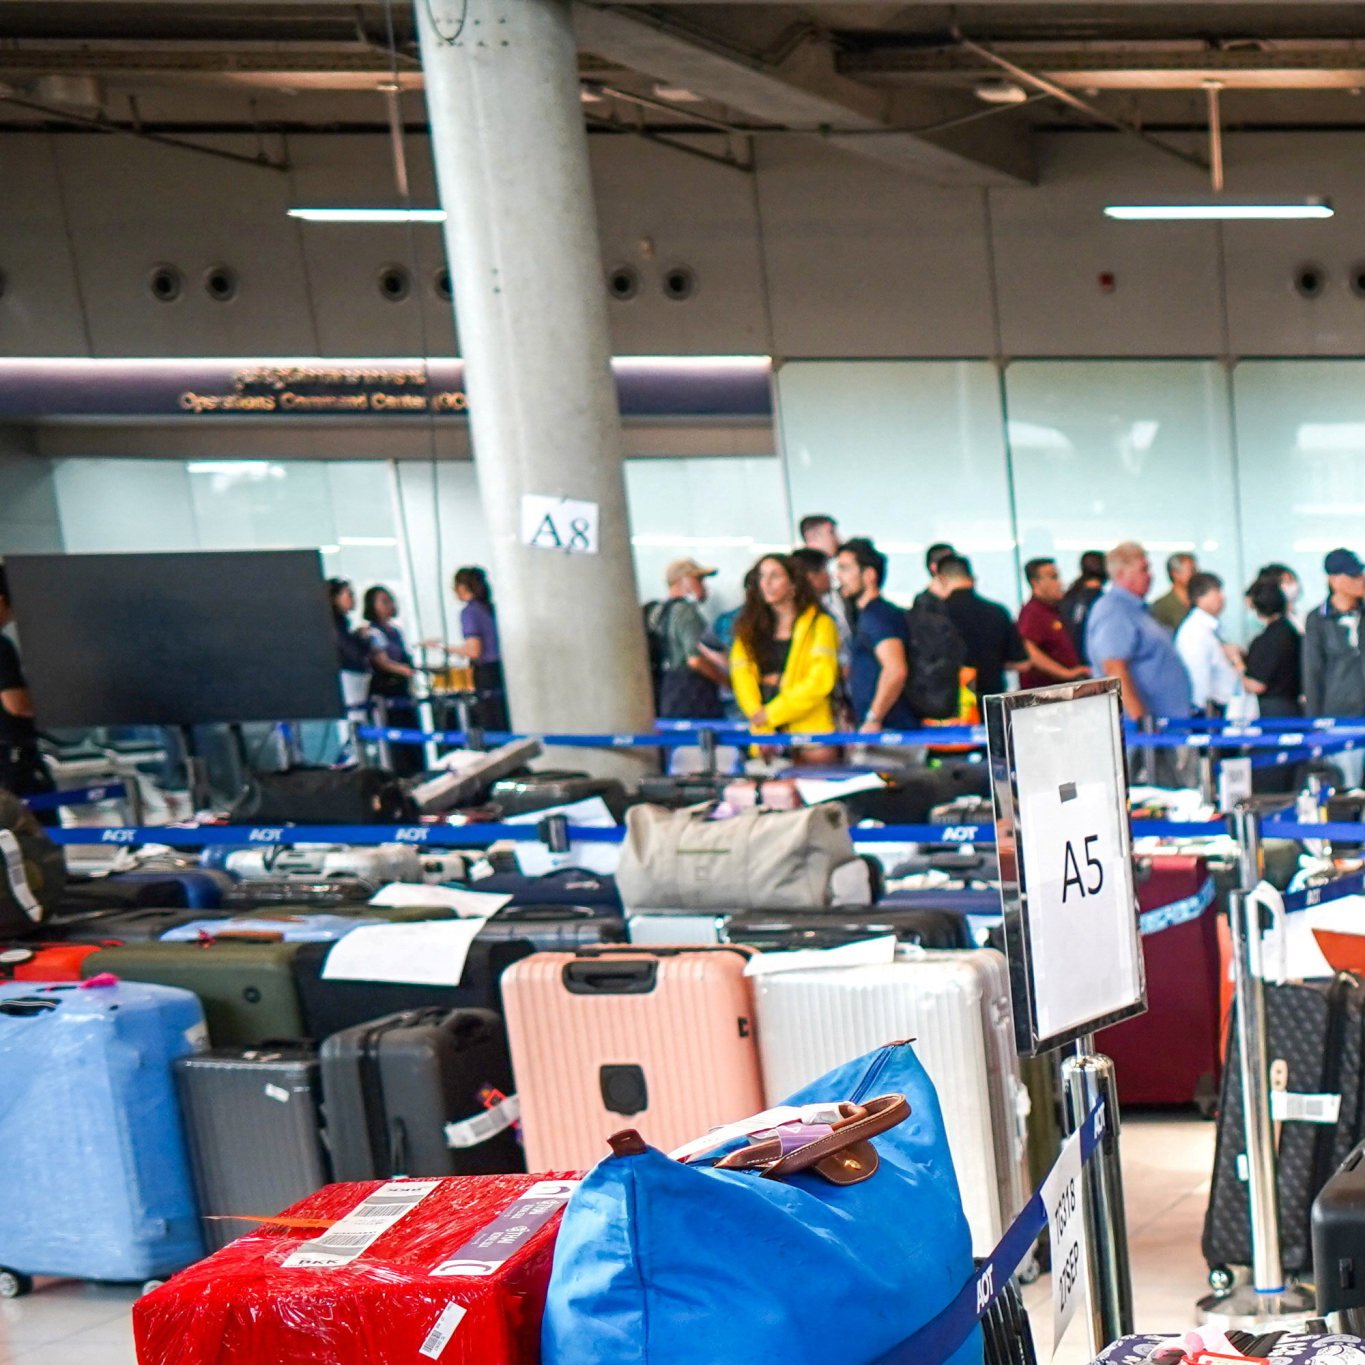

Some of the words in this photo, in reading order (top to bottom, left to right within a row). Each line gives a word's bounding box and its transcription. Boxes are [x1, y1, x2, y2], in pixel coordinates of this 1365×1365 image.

[530, 513, 590, 550] A8
[102, 829, 137, 842] AOT
[249, 828, 284, 842] AOT
[395, 828, 430, 841] AOT
[942, 826, 978, 841] AOT
[1061, 834, 1105, 904] A5
[976, 1263, 994, 1315] AOT
[1058, 1240, 1079, 1313] 27SEP
